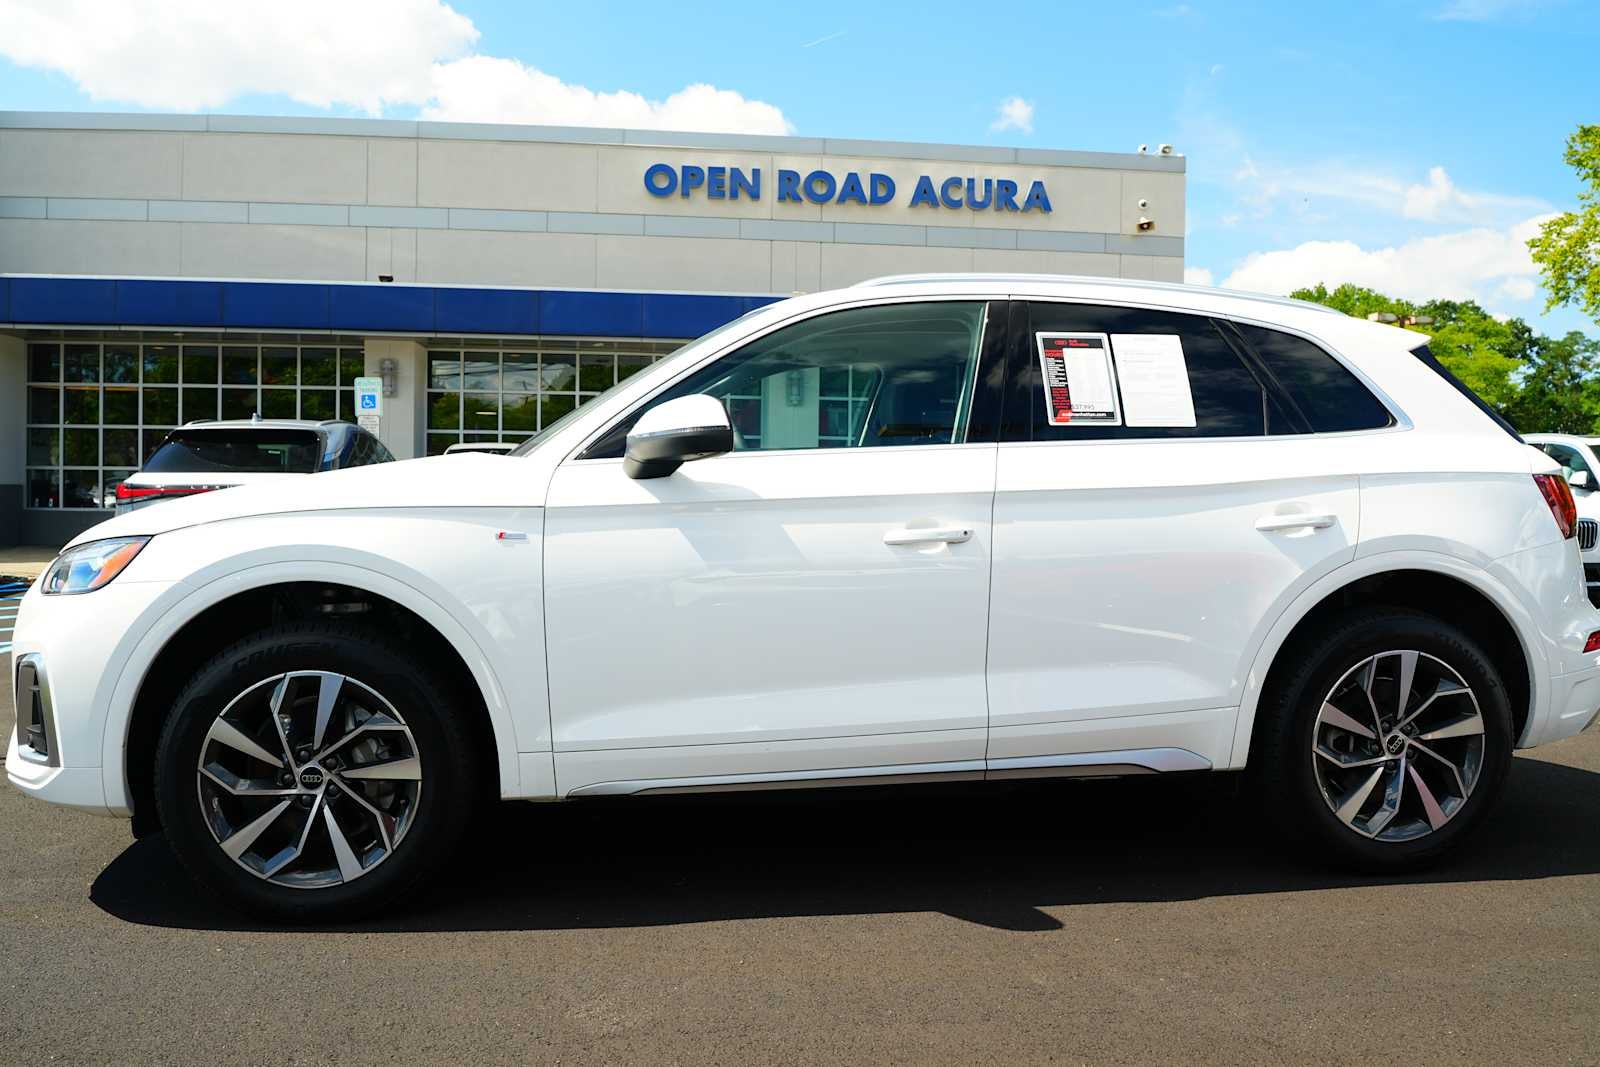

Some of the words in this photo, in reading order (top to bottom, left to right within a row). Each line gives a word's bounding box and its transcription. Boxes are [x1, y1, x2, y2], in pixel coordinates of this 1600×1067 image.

[644, 163, 761, 201] OPEN
[778, 169, 896, 206] ROAD
[909, 175, 1053, 214] ACURA
